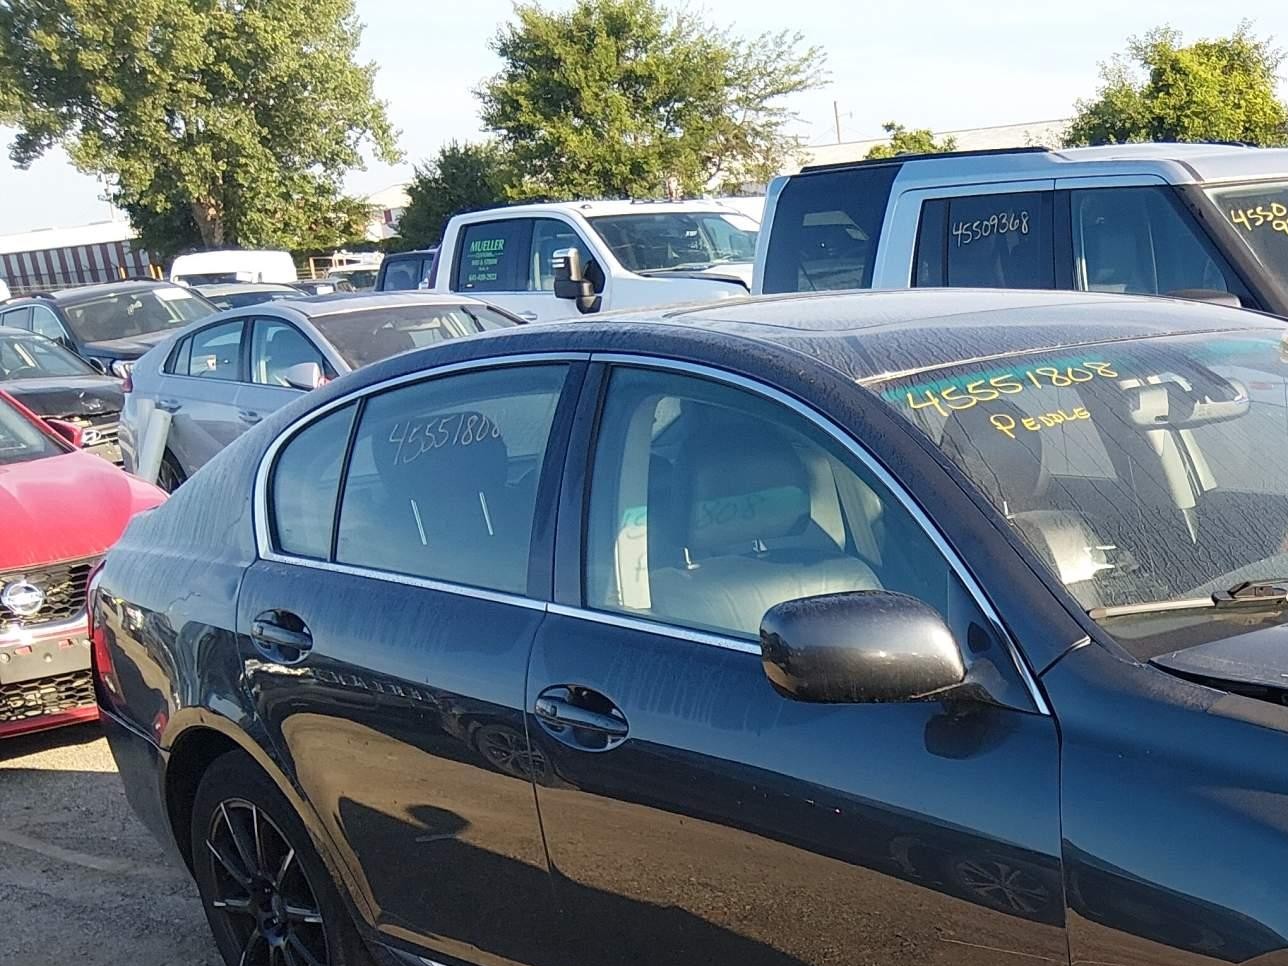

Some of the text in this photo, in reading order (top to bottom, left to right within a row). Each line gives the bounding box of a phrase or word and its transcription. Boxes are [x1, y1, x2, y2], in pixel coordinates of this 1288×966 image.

[952, 211, 1029, 247] 45509368
[1230, 202, 1287, 231] 4550
[470, 239, 505, 251] MUELLER
[906, 361, 1118, 417] 45551808
